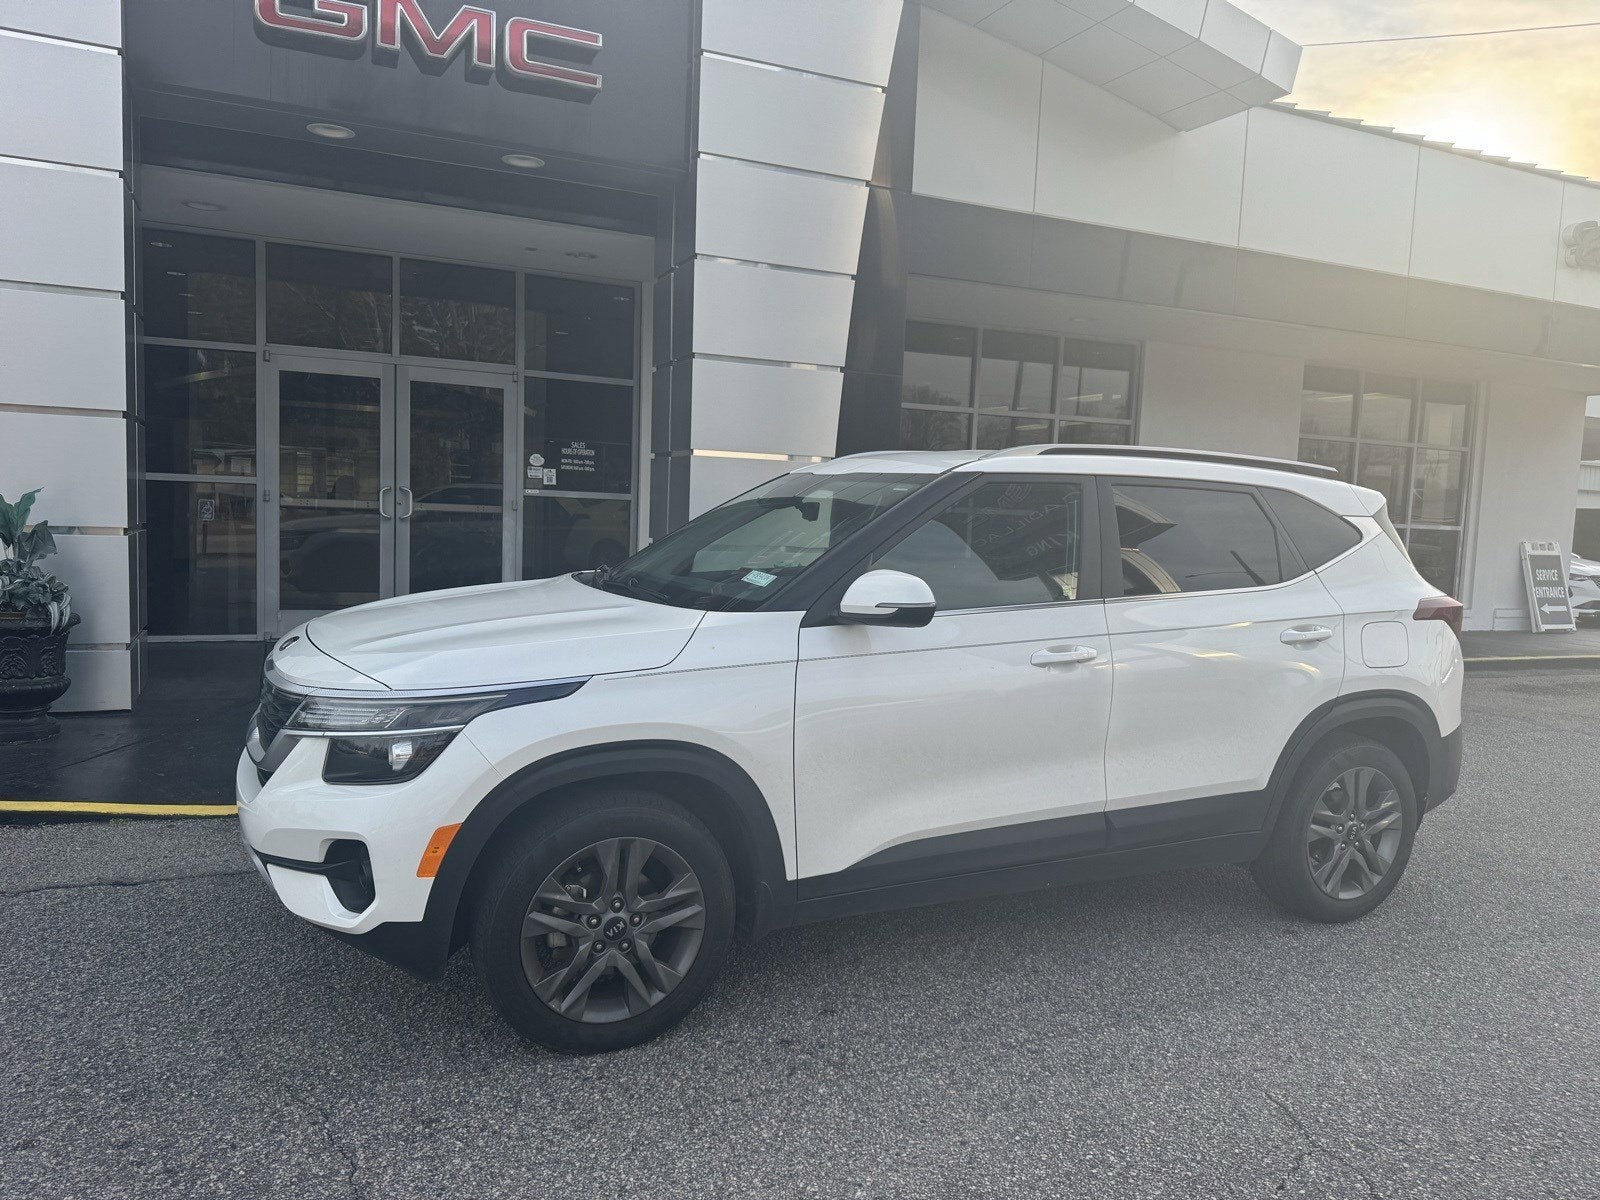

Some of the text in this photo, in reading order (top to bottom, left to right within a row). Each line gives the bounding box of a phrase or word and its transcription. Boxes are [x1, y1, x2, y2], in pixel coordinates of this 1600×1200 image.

[254, 0, 603, 89] GMC
[1536, 568, 1558, 580] SERVICE
[1535, 586, 1565, 597] ENTRANCE
[606, 921, 625, 936] KIA
